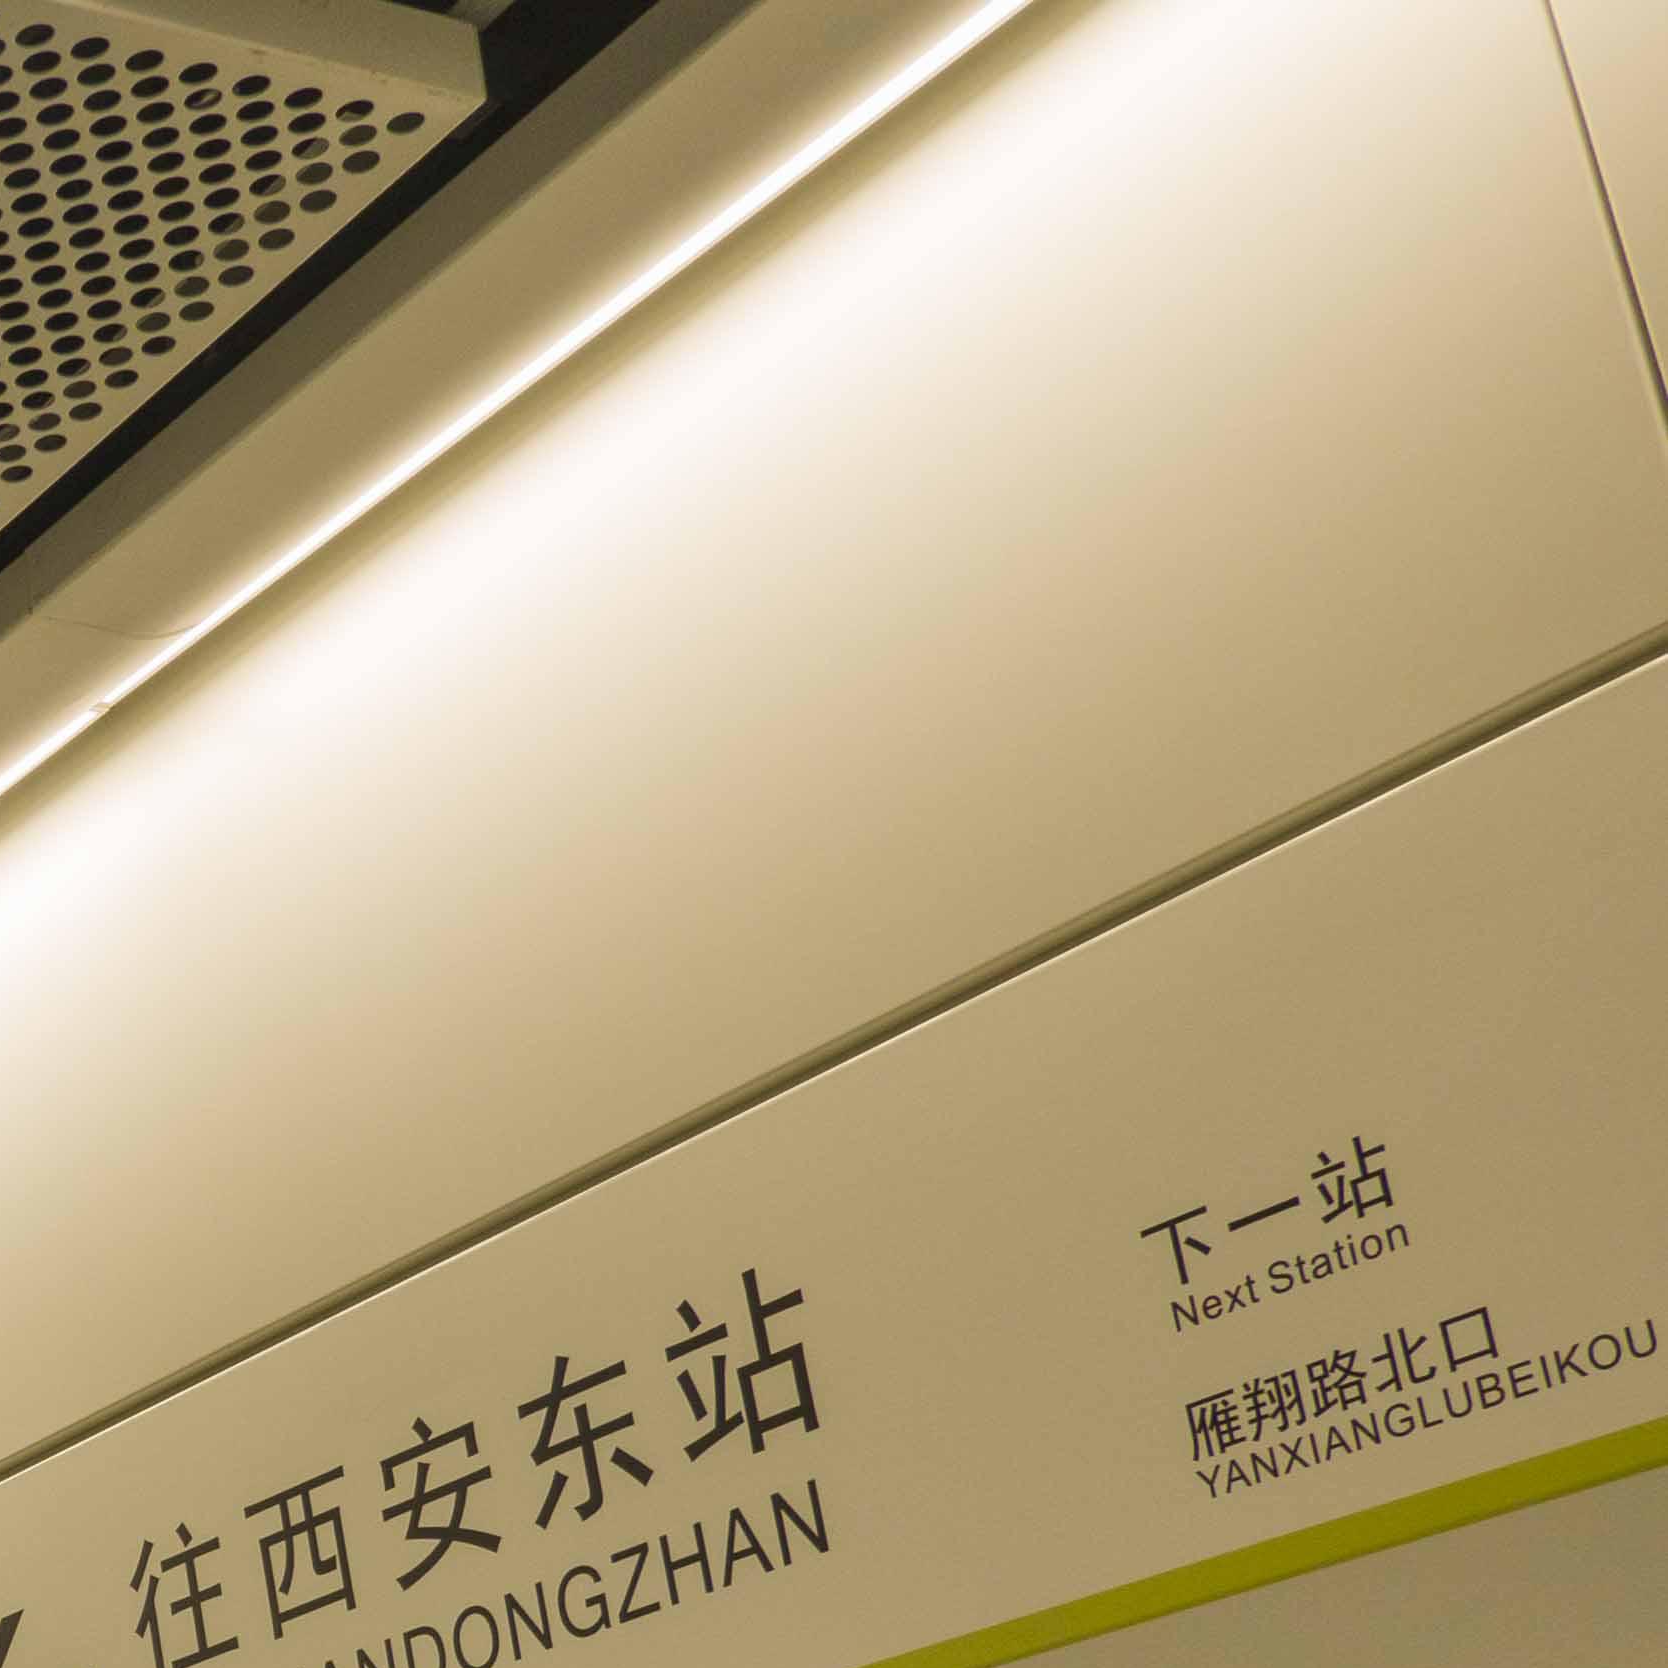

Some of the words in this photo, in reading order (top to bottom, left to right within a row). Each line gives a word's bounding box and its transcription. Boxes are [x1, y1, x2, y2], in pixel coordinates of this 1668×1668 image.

[1140, 1135, 1393, 1285] 下一站
[1169, 1275, 1260, 1332] Next
[1268, 1223, 1410, 1294] Station
[1185, 1306, 1498, 1462] 雁翔路北口
[1195, 1319, 1658, 1500] YANXIANGLUBEIKOU
